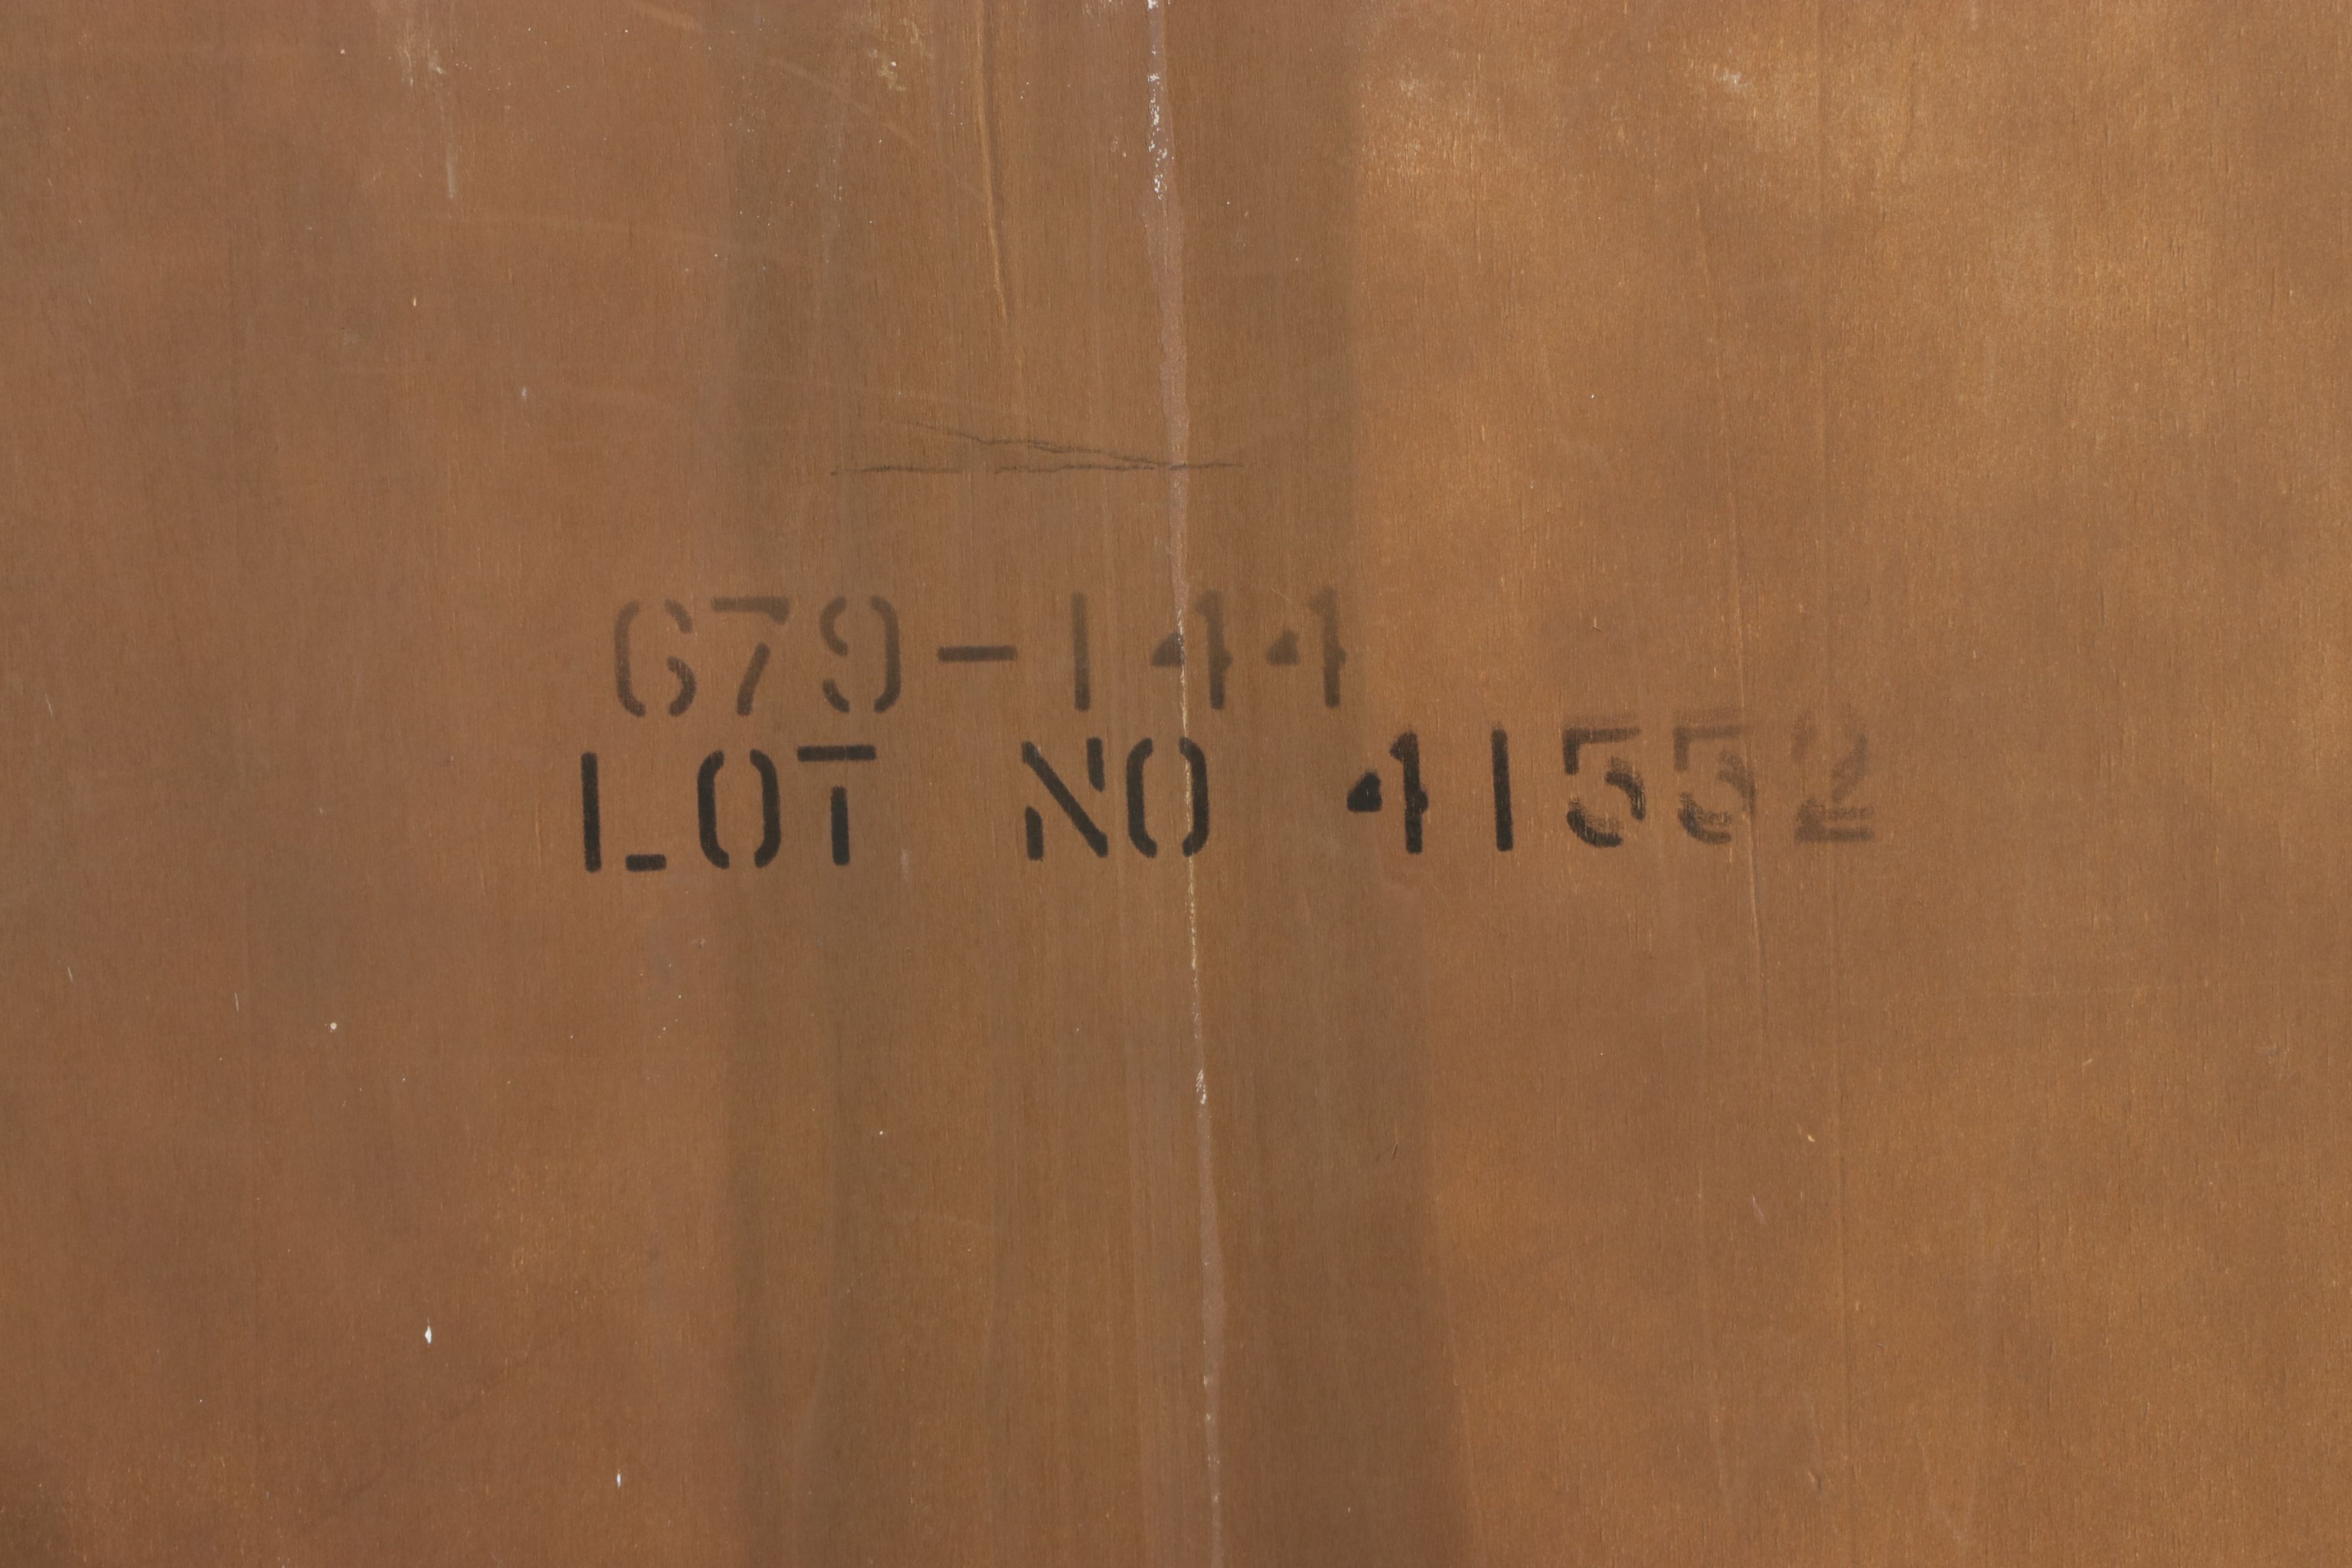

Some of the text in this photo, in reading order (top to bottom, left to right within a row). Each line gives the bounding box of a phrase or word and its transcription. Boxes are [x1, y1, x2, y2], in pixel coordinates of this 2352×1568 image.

[613, 587, 1347, 717] 679-144
[580, 708, 1876, 873] LOT NO 41552
